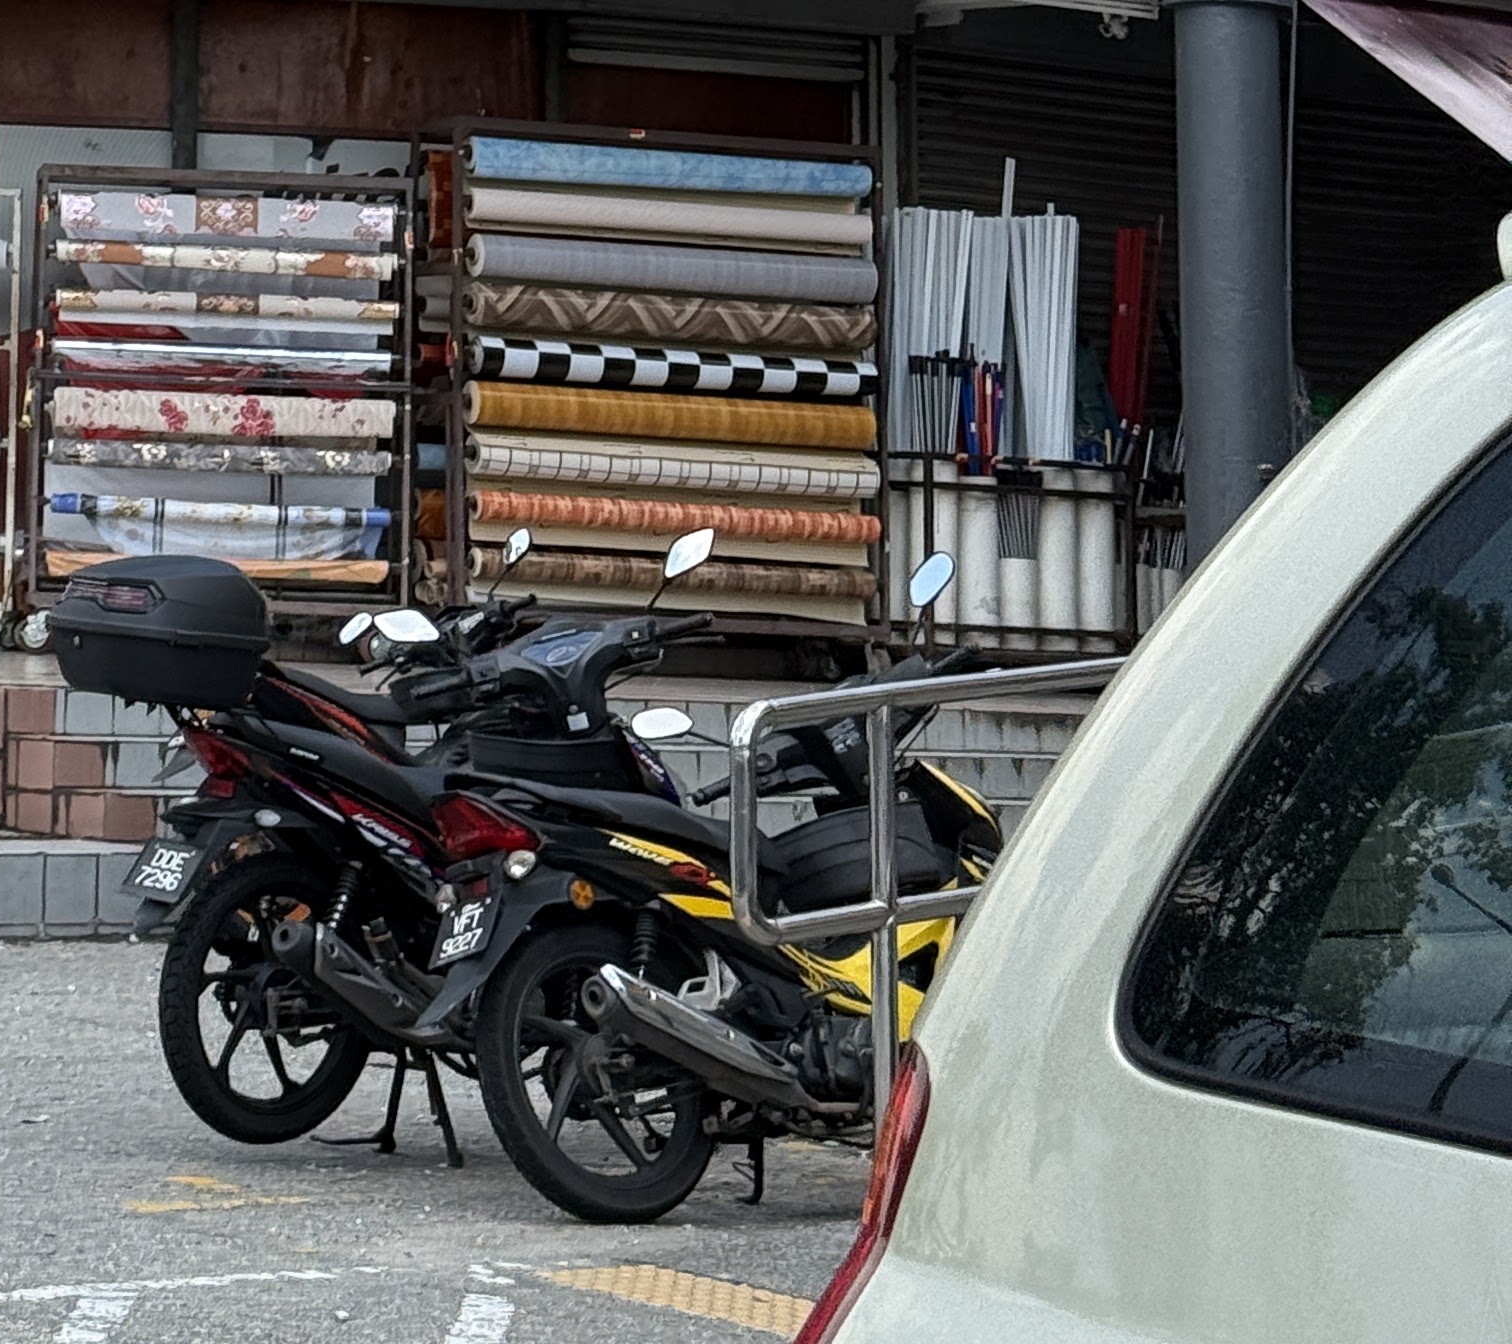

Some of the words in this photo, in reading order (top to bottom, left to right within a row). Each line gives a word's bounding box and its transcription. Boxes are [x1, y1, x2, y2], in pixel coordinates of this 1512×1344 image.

[150, 848, 190, 872] DDE
[135, 865, 182, 892] 7296
[453, 907, 484, 935] VFT
[439, 928, 484, 958] 9227
